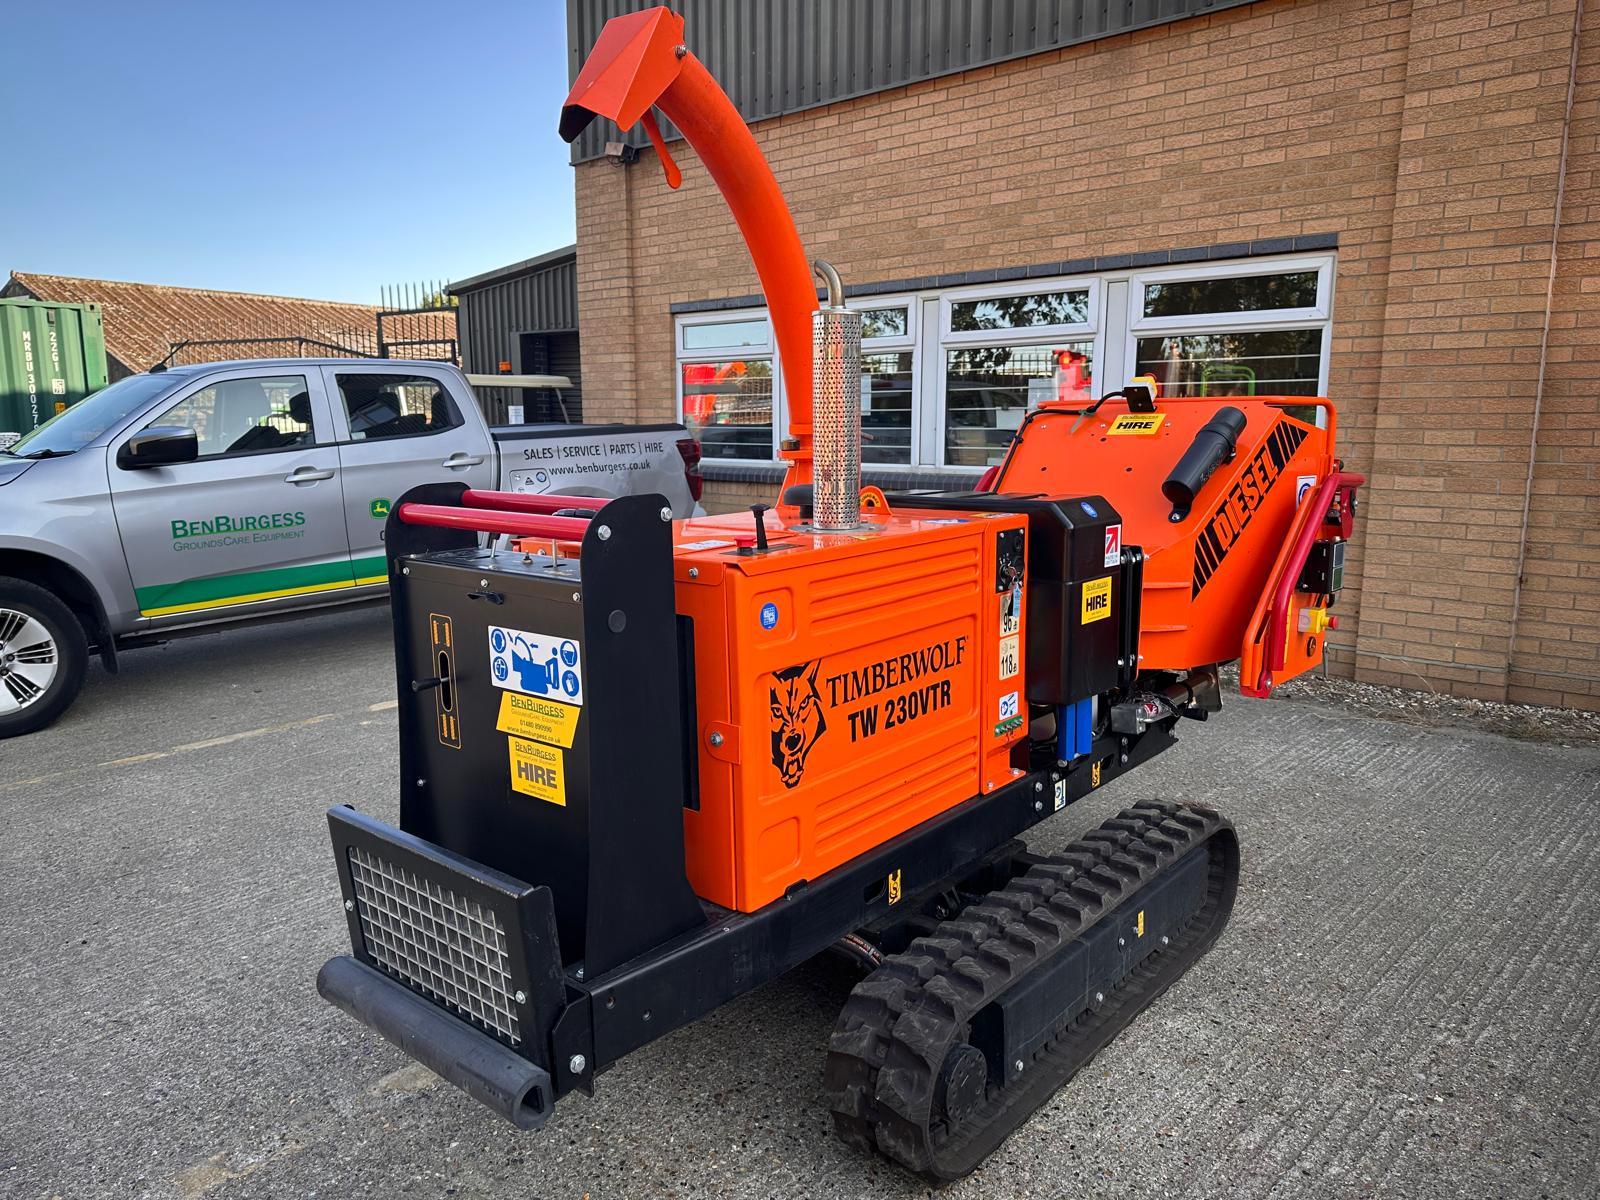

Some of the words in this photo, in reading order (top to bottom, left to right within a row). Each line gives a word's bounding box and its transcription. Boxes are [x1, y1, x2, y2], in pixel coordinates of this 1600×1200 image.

[22, 331, 34, 372] MRBU
[49, 332, 60, 372] 22G1
[1116, 421, 1155, 429] HIRE
[523, 447, 554, 461] SALES
[564, 445, 601, 458] SERVICE
[610, 443, 637, 455] PARTS
[644, 442, 664, 453] HIRE
[549, 459, 651, 476] www.benburgess.co.uk
[1211, 445, 1280, 553] DIESEL
[1086, 593, 1107, 612] HIRE
[826, 635, 966, 709] TIMBERWOLF
[1001, 653, 1013, 677] 118
[848, 704, 878, 743] TW
[884, 679, 951, 730] 230VTR
[517, 759, 558, 789] HIRE
